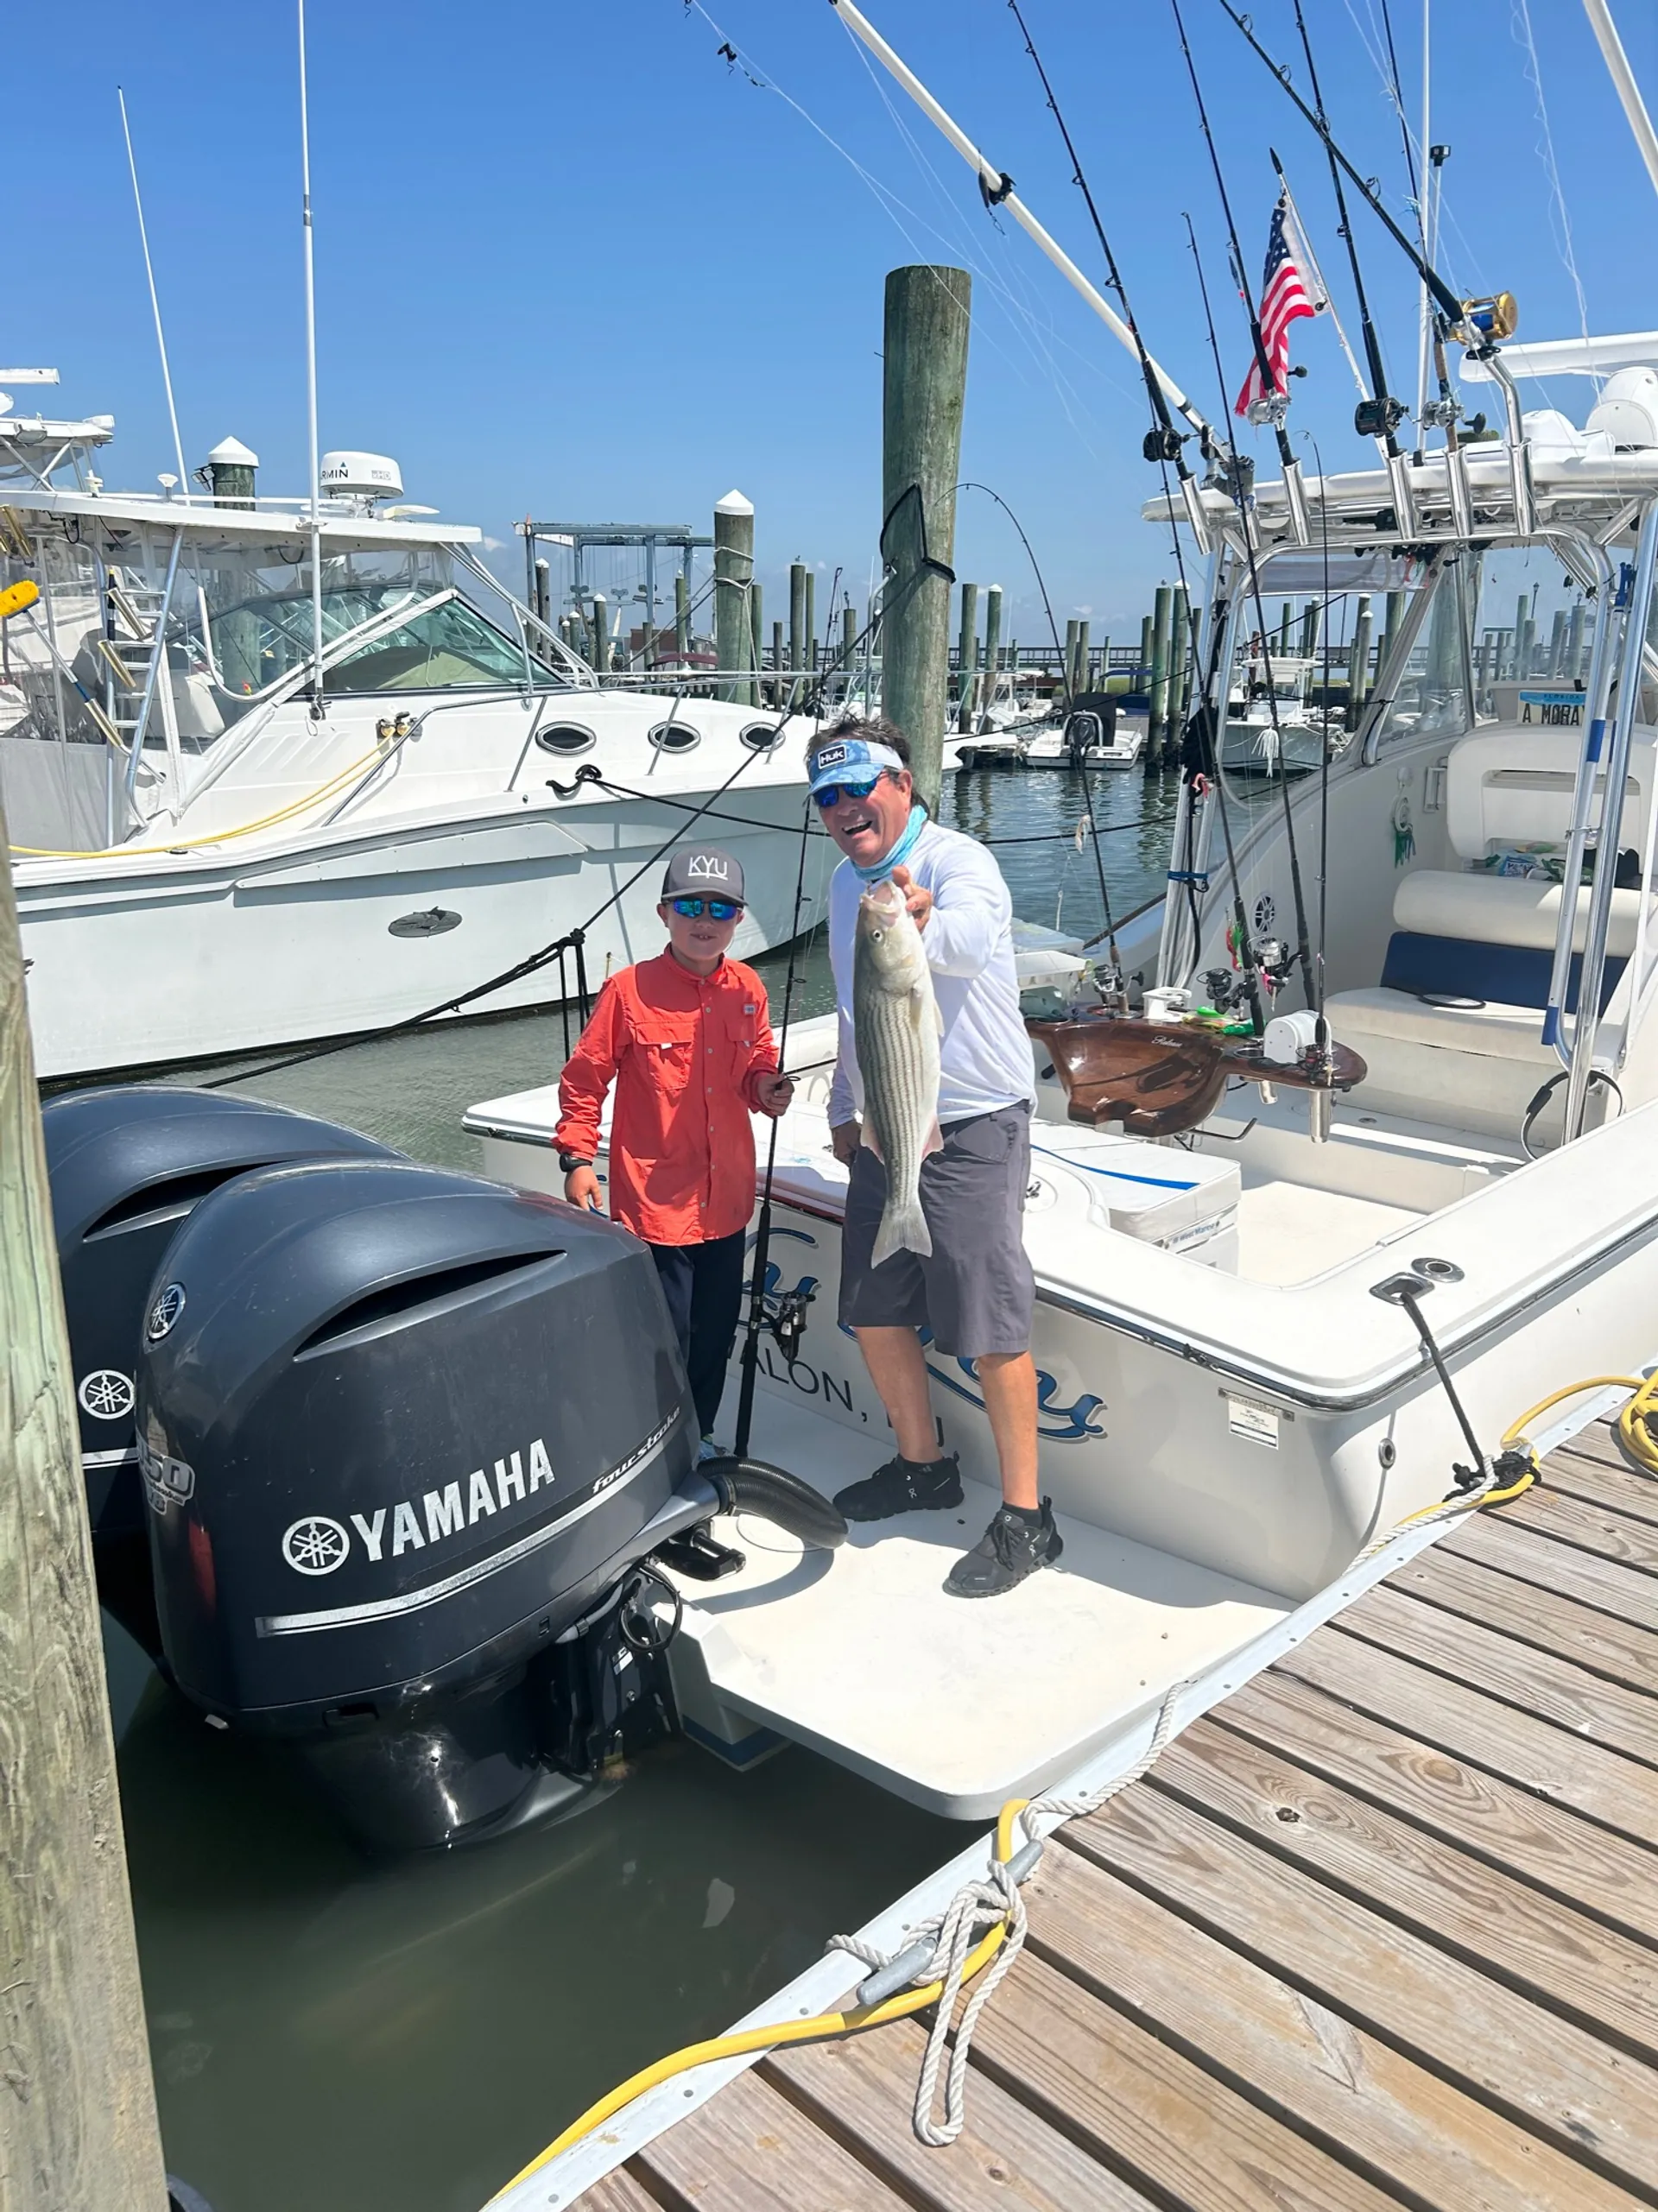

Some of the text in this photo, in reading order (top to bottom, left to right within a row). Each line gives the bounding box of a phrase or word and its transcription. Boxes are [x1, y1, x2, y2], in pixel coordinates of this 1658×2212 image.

[320, 469, 349, 480] RMIN
[1522, 703, 1585, 726] A MORA
[592, 1406, 680, 1494] fourstroke
[350, 1438, 555, 1562] YAMAHA
